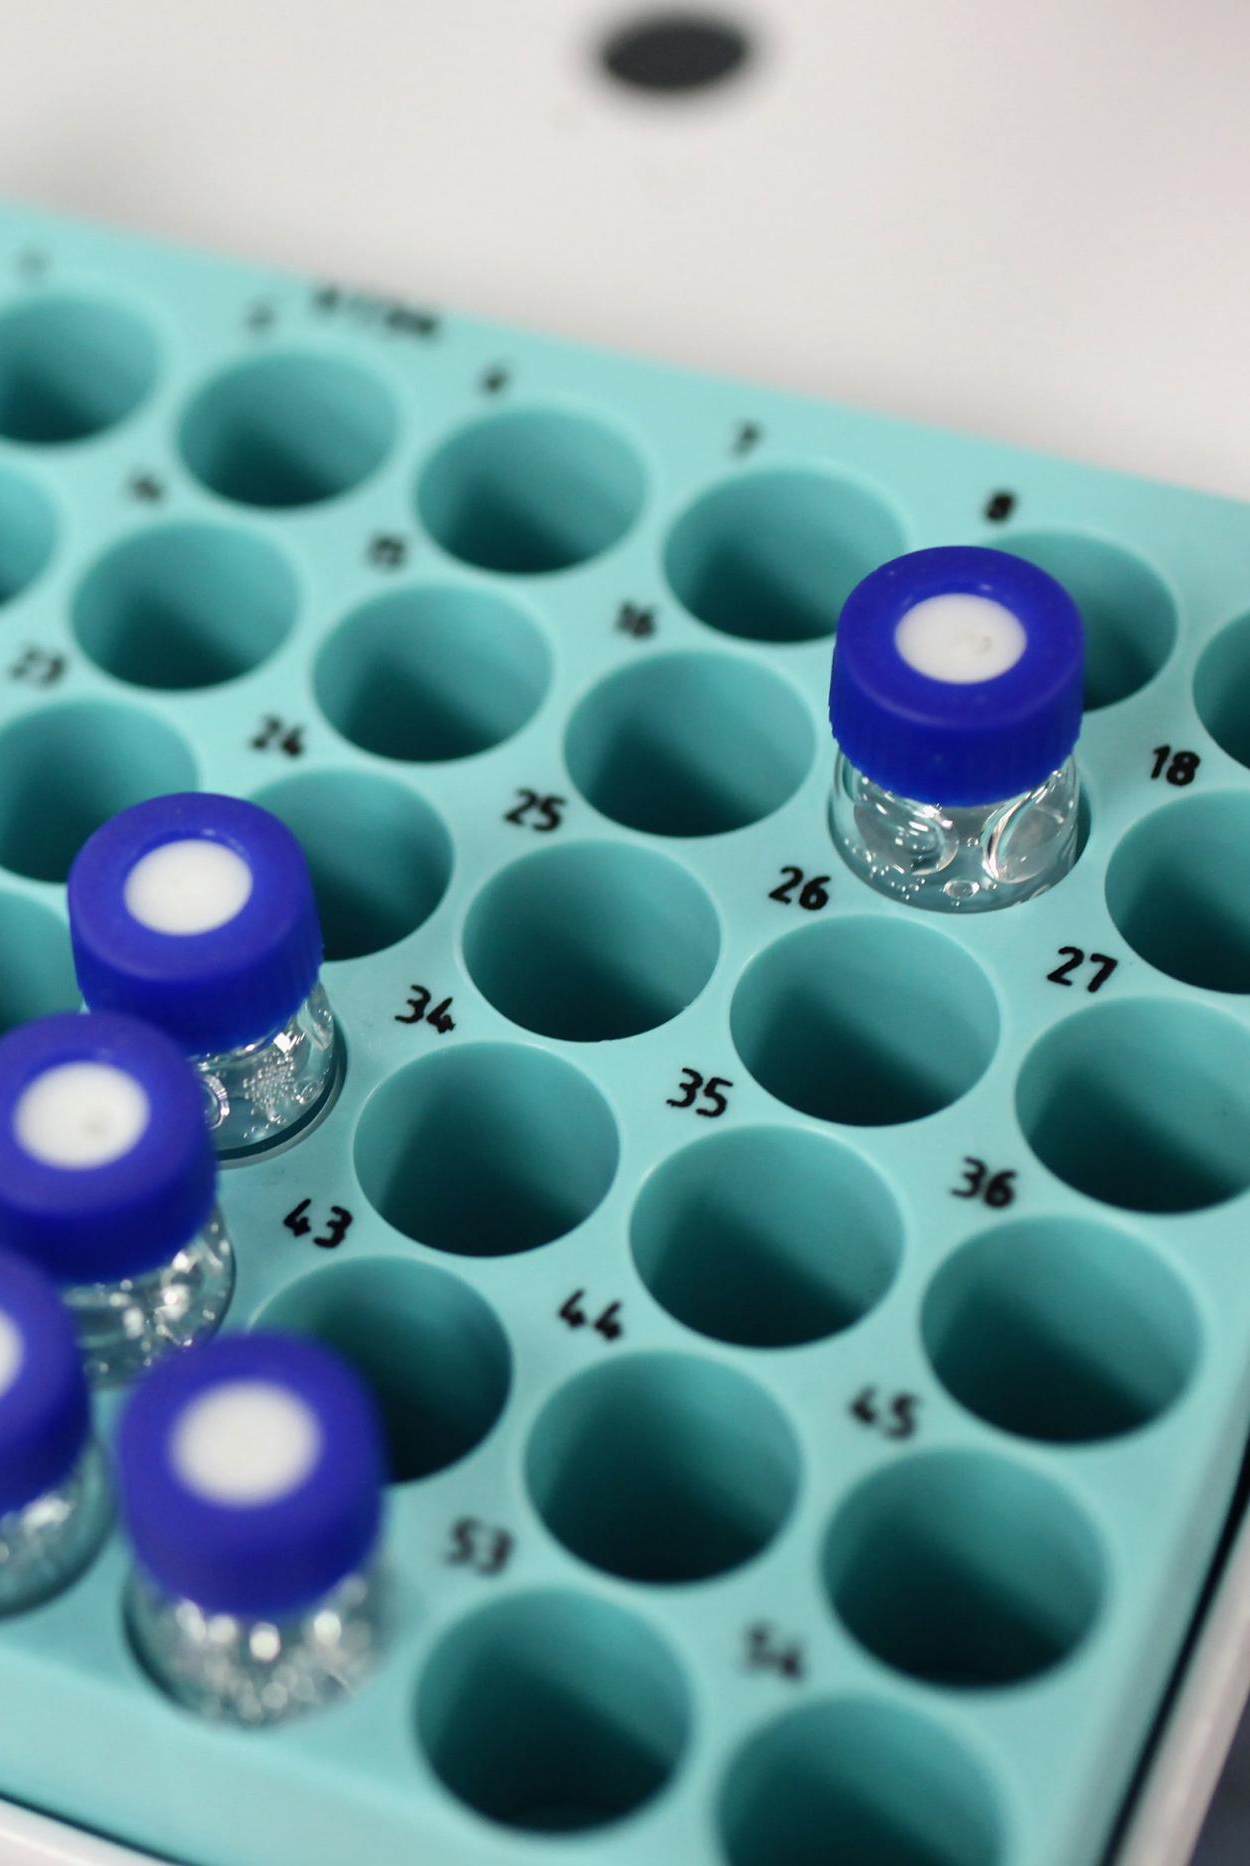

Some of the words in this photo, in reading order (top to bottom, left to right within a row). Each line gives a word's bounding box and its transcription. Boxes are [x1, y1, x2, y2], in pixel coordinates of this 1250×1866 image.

[983, 490, 1017, 525] 8
[252, 718, 304, 758] 24
[1150, 744, 1201, 787] 18
[505, 790, 565, 832] 25
[768, 866, 831, 911] 26
[1046, 946, 1118, 993] 27
[395, 985, 455, 1034] 34
[666, 1068, 733, 1118] 35
[952, 1158, 1016, 1210] 36
[283, 1198, 353, 1249] 43
[558, 1290, 622, 1341] 44
[847, 1387, 918, 1442] 45
[446, 1516, 515, 1577] 53
